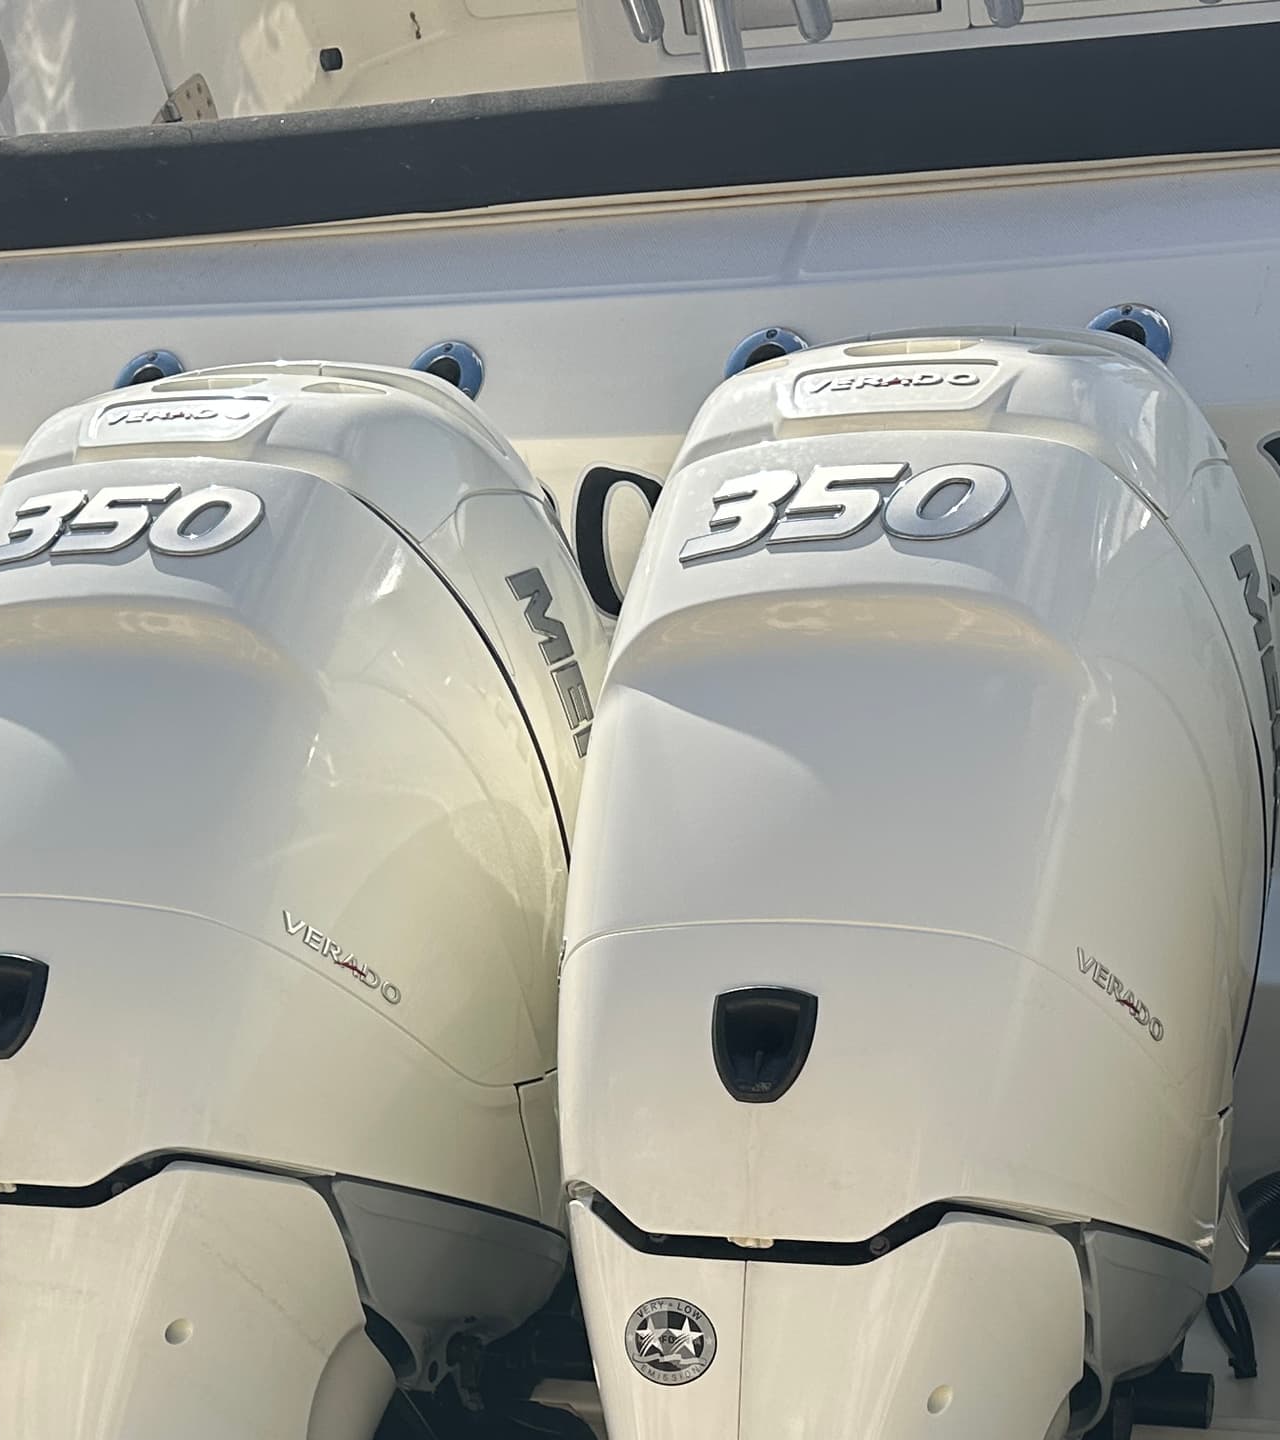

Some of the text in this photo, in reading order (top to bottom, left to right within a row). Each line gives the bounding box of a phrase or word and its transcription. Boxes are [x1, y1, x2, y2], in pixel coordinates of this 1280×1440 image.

[803, 372, 981, 395] VERADO
[677, 460, 1013, 567] 350
[282, 909, 402, 1005] VERADO
[1076, 946, 1165, 1042] VERADO
[636, 1300, 703, 1320] VERY LOW
[640, 1364, 702, 1382] EMISSION
